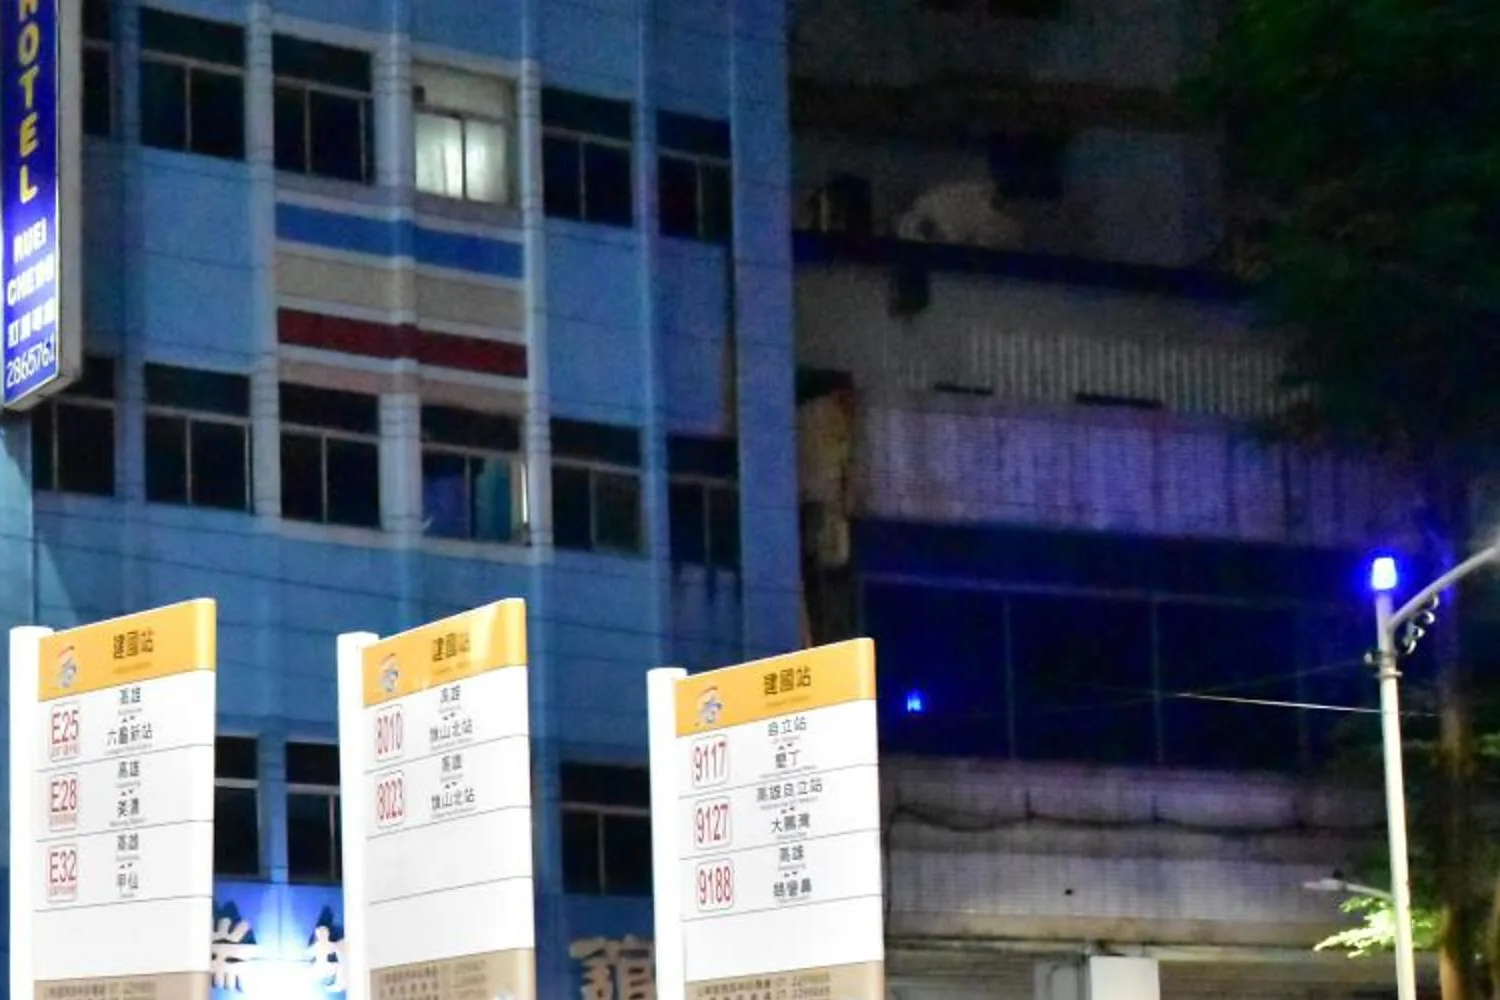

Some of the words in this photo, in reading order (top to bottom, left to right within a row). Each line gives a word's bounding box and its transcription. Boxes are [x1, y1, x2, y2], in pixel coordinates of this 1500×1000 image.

[764, 666, 811, 696] 建國站
[52, 709, 79, 745] E25
[694, 742, 727, 782] 9117
[51, 779, 77, 813] E28
[697, 804, 729, 843] 9127
[50, 849, 77, 883] E32
[698, 866, 732, 905] 9188
